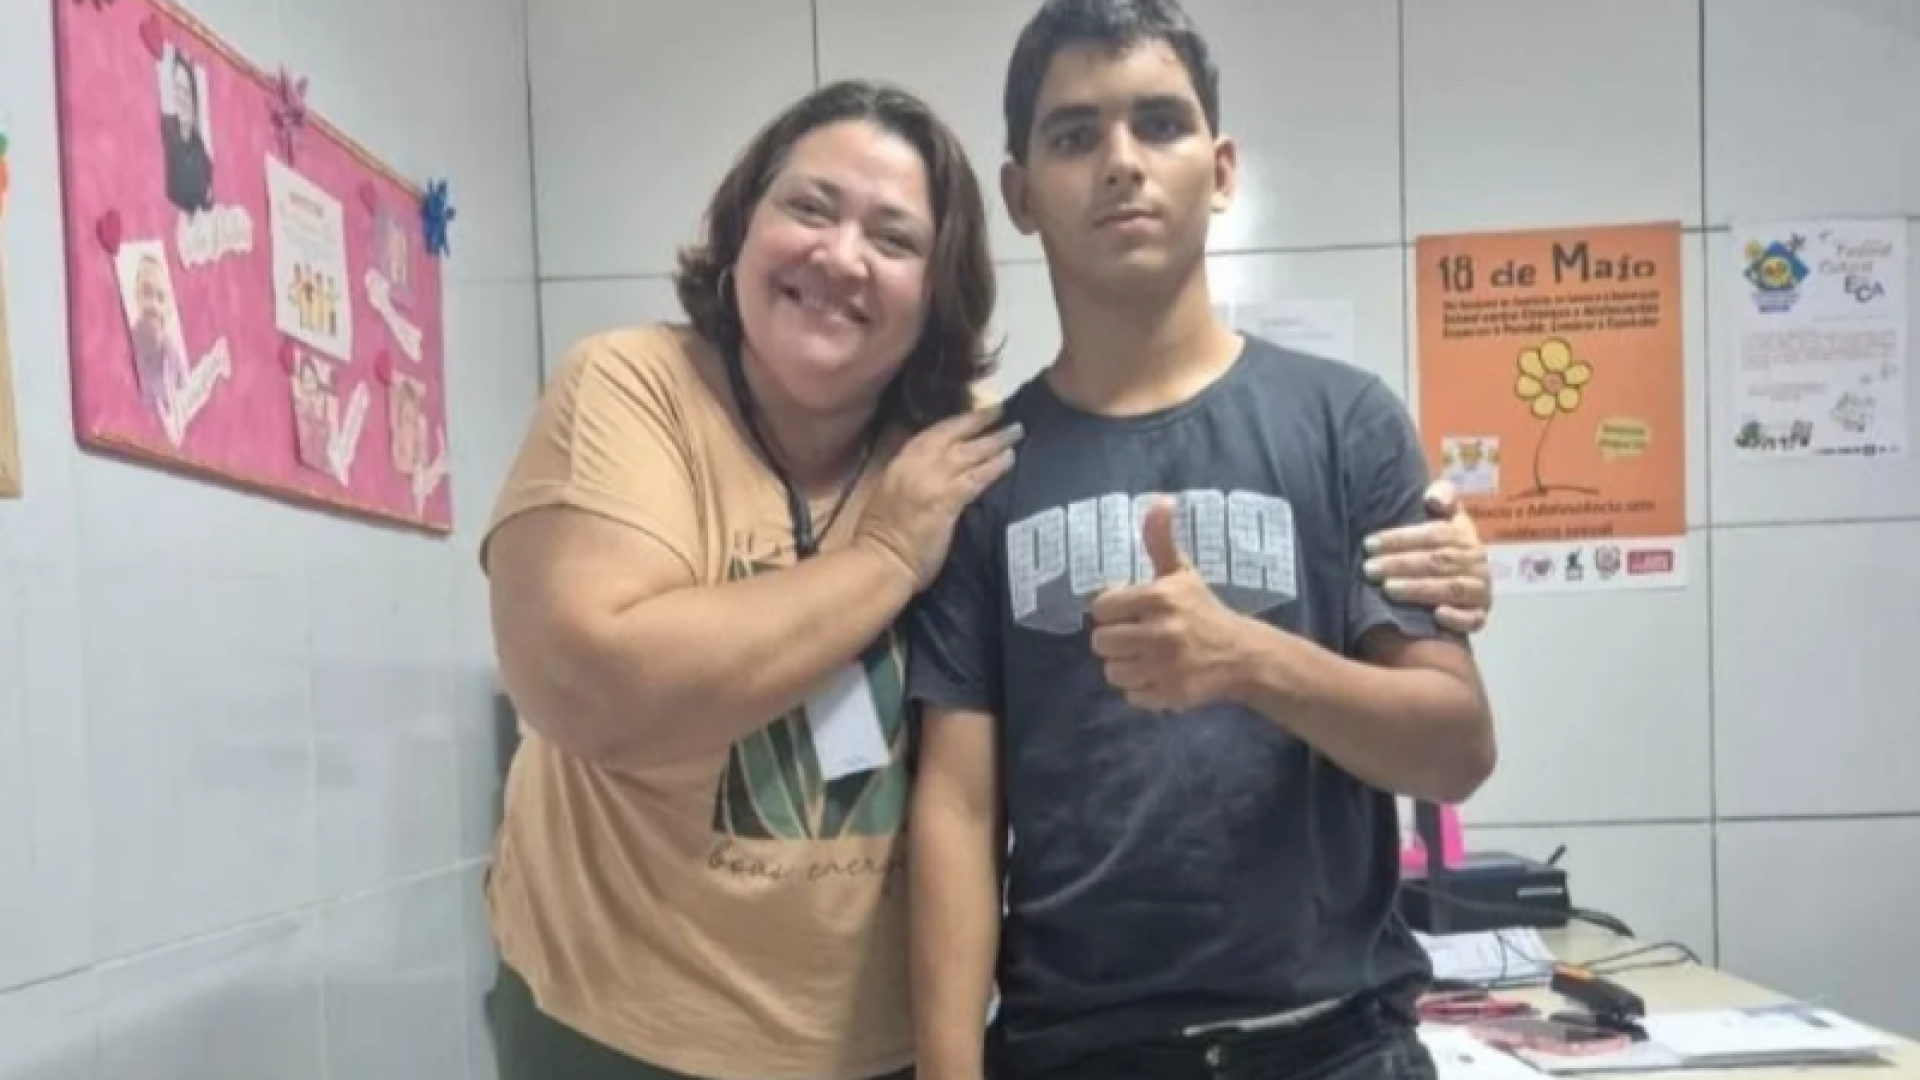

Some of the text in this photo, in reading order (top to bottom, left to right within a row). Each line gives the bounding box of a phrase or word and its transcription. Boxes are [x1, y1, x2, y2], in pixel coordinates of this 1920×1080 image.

[1438, 255, 1475, 293] 18
[1490, 260, 1537, 287] de
[1007, 488, 1298, 622] PUMA
